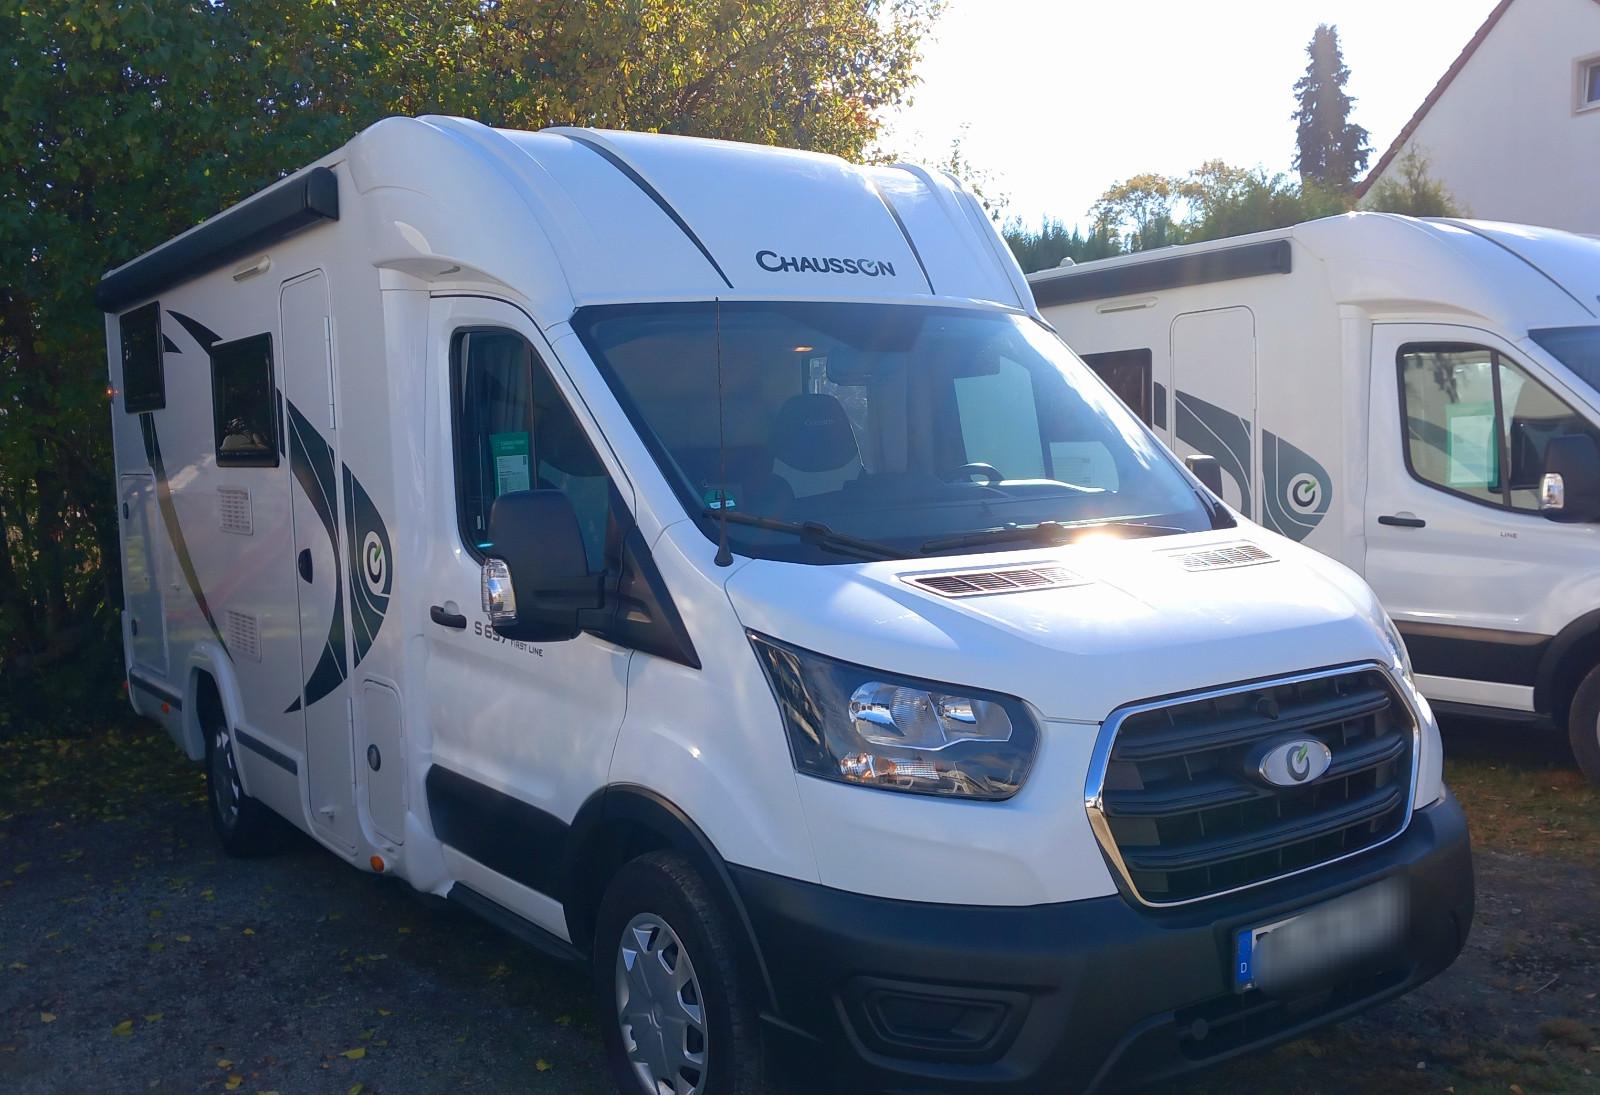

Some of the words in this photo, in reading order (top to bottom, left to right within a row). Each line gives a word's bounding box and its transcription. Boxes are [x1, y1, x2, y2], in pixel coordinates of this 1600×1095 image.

[755, 250, 896, 277] CHAUSSON
[474, 621, 483, 636] S
[510, 639, 527, 652] FIRST
[528, 645, 544, 657] LINE
[1240, 962, 1247, 974] D
